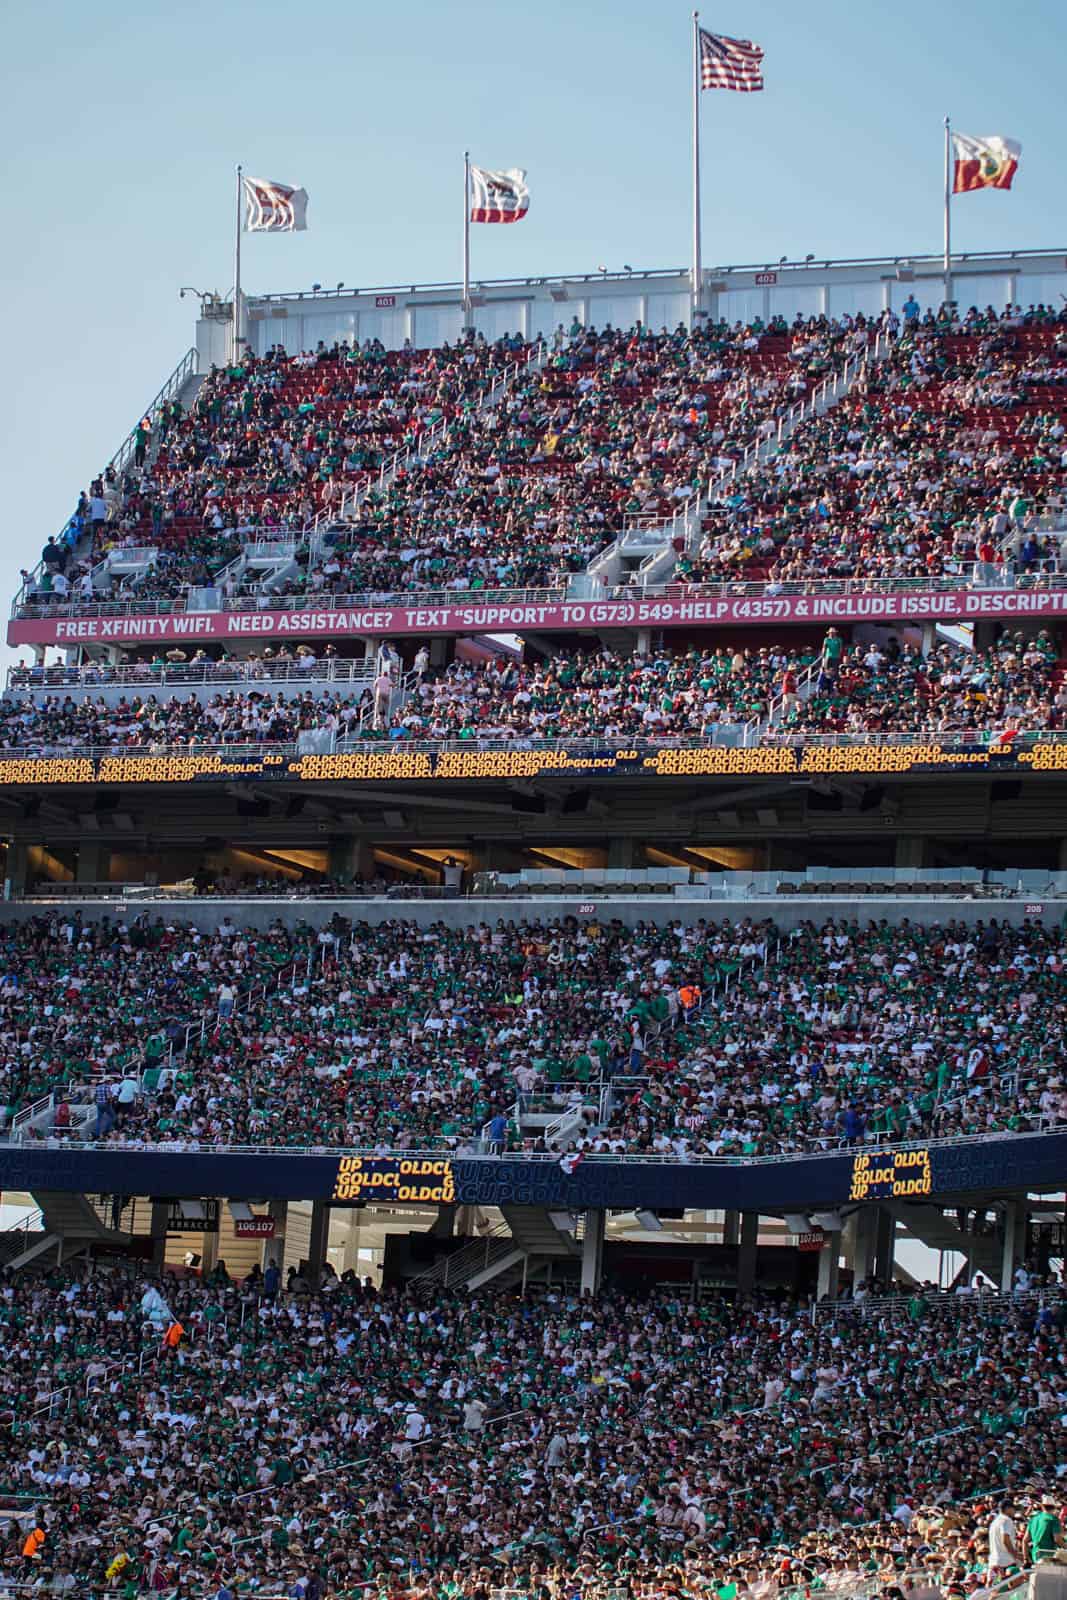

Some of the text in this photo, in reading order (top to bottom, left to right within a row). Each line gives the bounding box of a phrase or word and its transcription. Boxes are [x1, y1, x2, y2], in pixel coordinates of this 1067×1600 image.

[56, 622, 97, 637] FREE
[101, 618, 170, 636] XFINITY
[173, 616, 215, 634] WIFI.
[228, 615, 274, 632] NEED
[277, 612, 393, 630] ASSISTANCE?
[406, 610, 450, 626] TEXT
[561, 606, 585, 622] TO
[589, 603, 635, 623] (573)
[638, 601, 729, 619] 549-HELP
[732, 599, 791, 618] (4357)
[792, 599, 809, 616] &
[813, 597, 896, 615] INCLUDE
[901, 596, 962, 615] ISSUE,
[263, 756, 283, 764] OLD
[616, 751, 638, 759] OLD
[988, 745, 1011, 754] OLD
[339, 1159, 362, 1172] UP
[854, 1156, 870, 1171] UP
